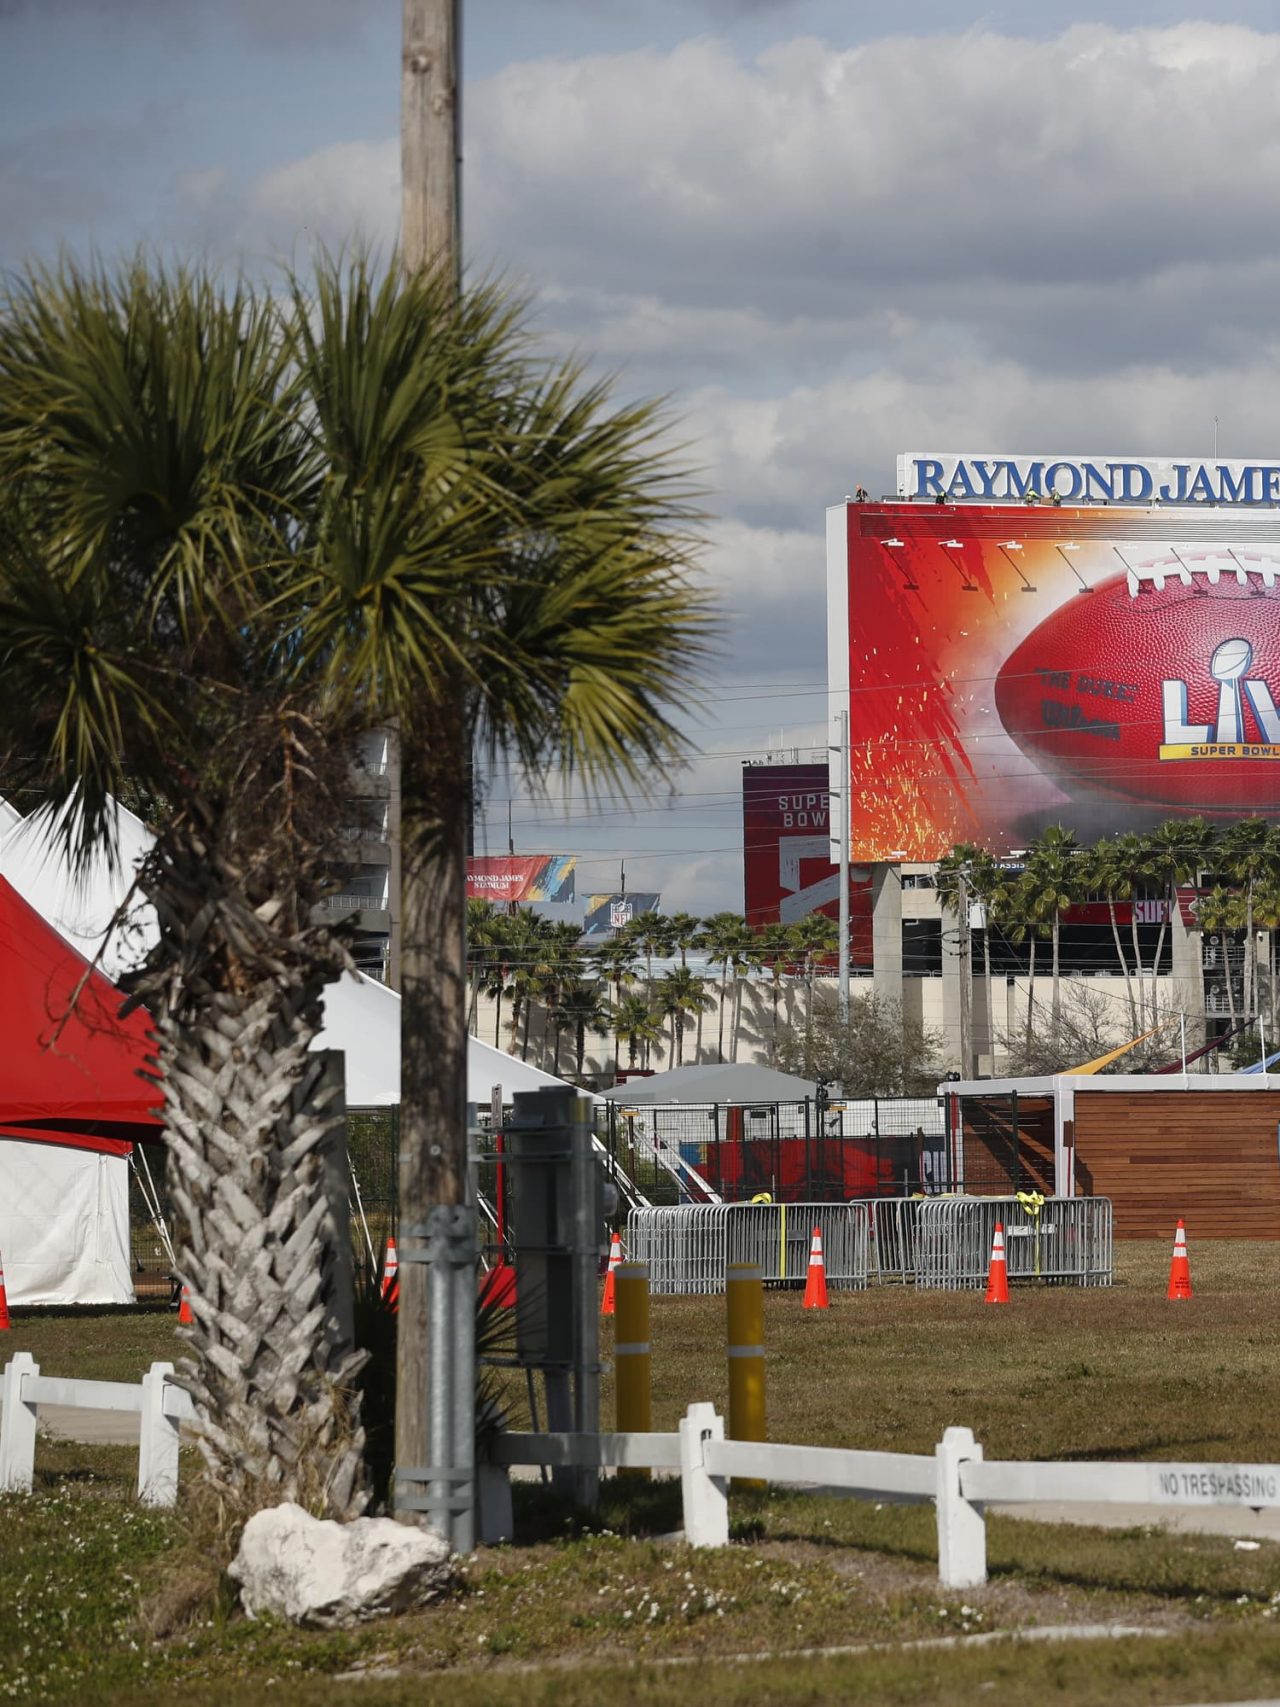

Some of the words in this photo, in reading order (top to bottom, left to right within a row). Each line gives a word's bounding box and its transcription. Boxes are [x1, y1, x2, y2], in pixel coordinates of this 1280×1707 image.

[912, 459, 1154, 500] RAYMOND
[1191, 746, 1236, 756] SUPER
[1242, 746, 1280, 756] BOWL
[778, 793, 830, 811] SUPE
[783, 811, 827, 828] BOW
[1160, 1473, 1179, 1496] NO
[1181, 1473, 1277, 1498] TRESPASSING
